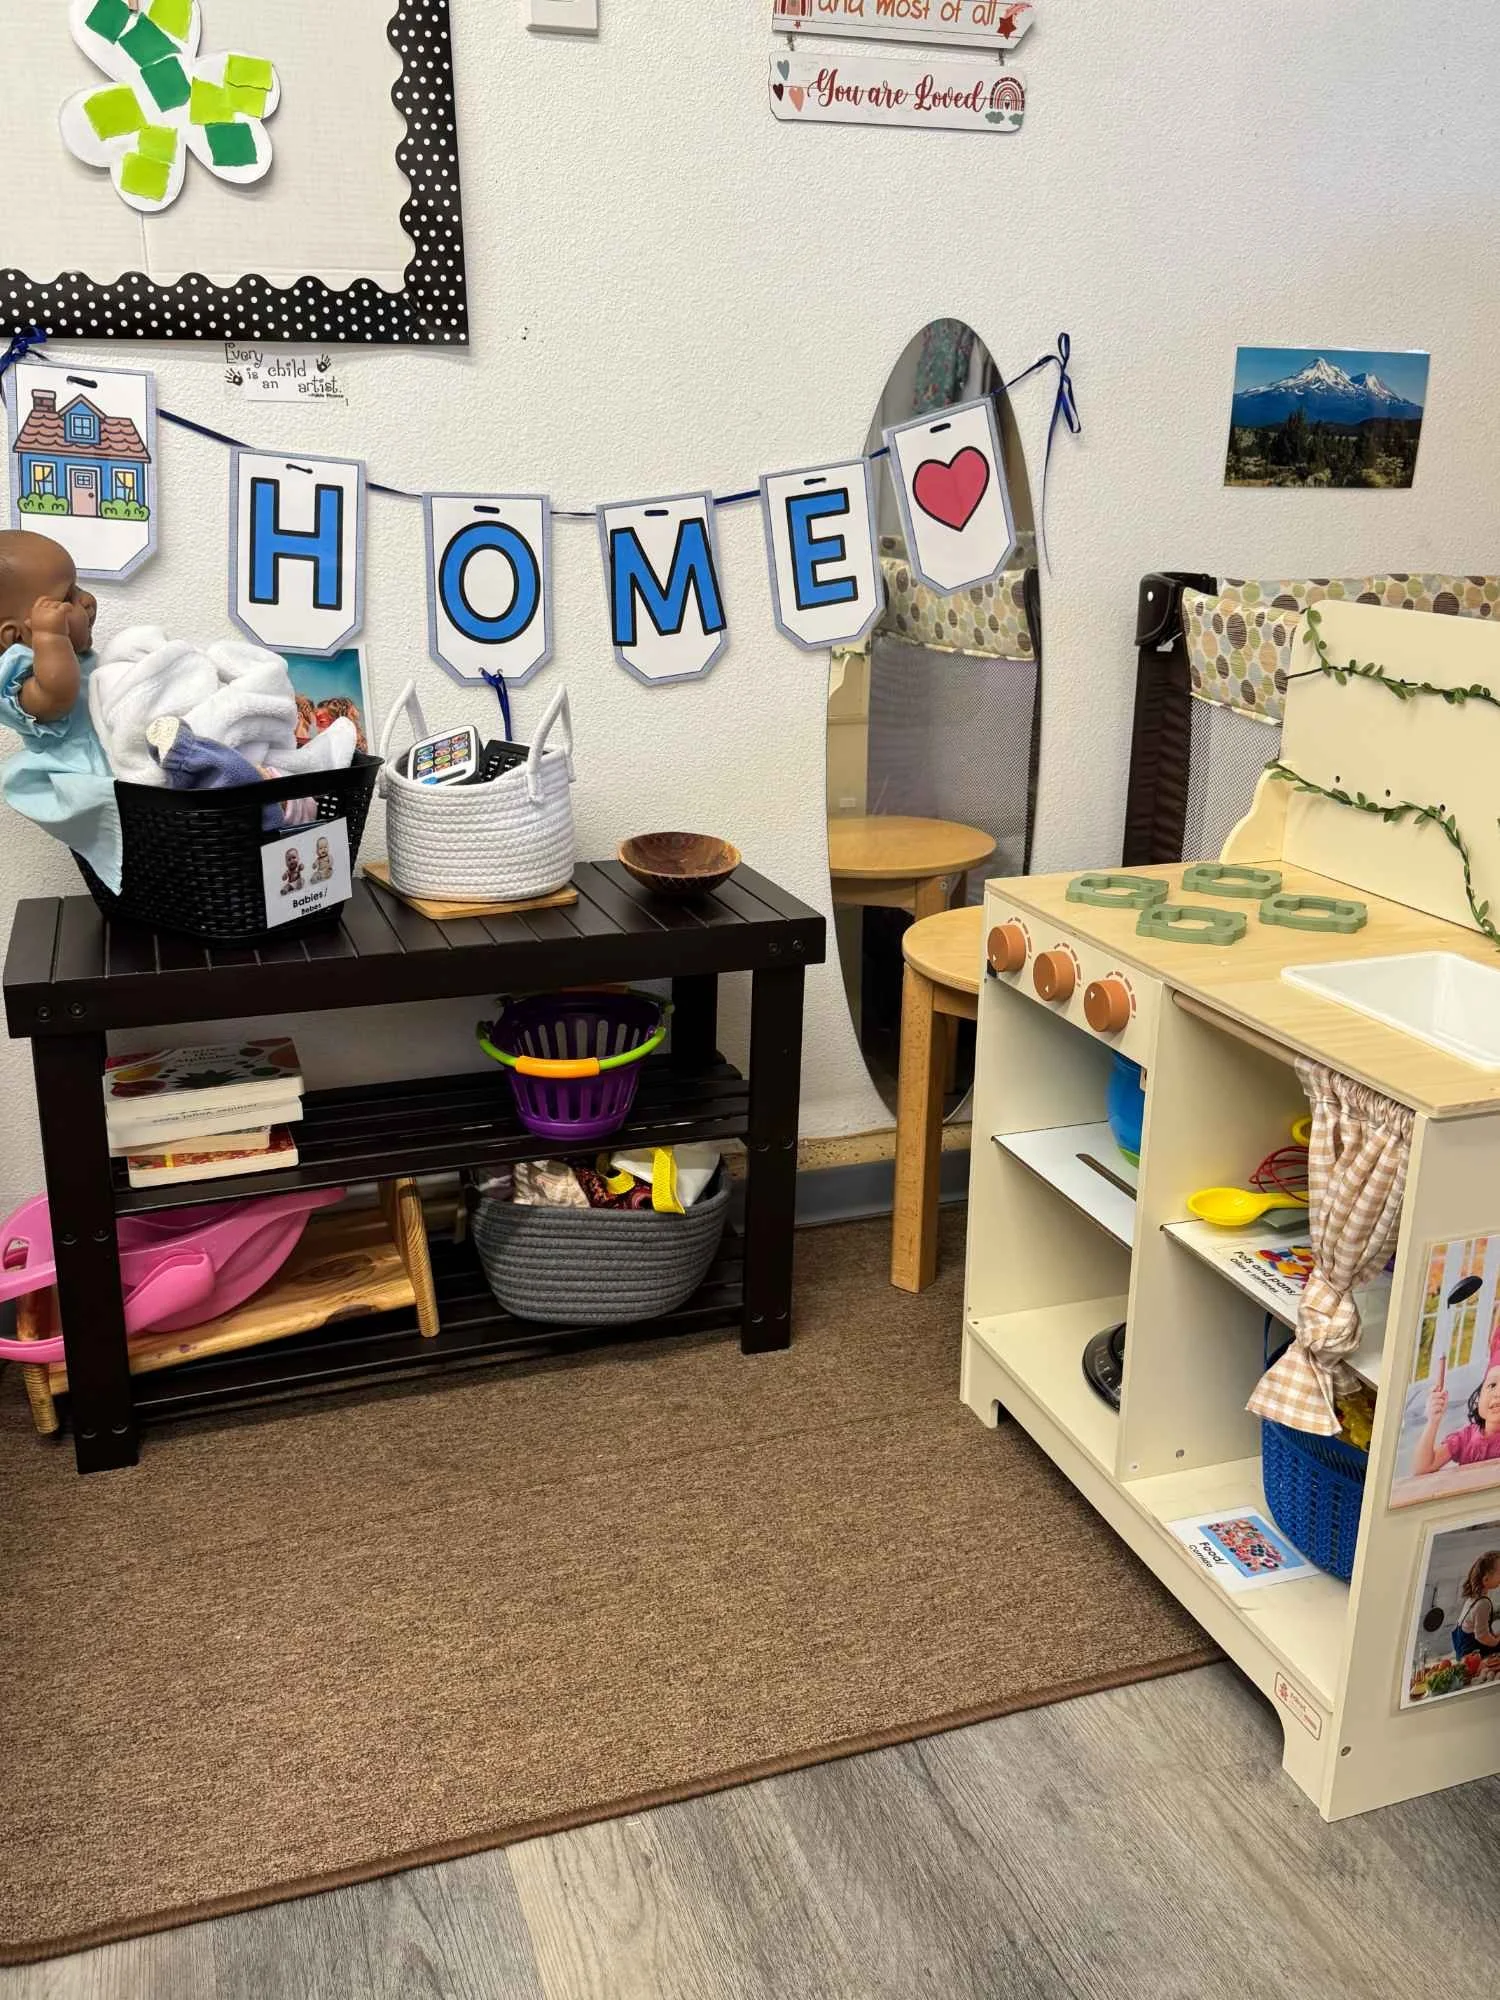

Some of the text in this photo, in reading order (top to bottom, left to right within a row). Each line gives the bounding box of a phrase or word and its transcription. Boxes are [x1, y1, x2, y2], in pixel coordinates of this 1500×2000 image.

[876, 0, 930, 20] most
[940, 0, 962, 22] of
[971, 0, 996, 25] all
[807, 68, 986, 113] You are Loved
[224, 342, 307, 378] Every child
[246, 367, 259, 380] is
[262, 380, 279, 389] an
[1252, 1264, 1275, 1277] and
